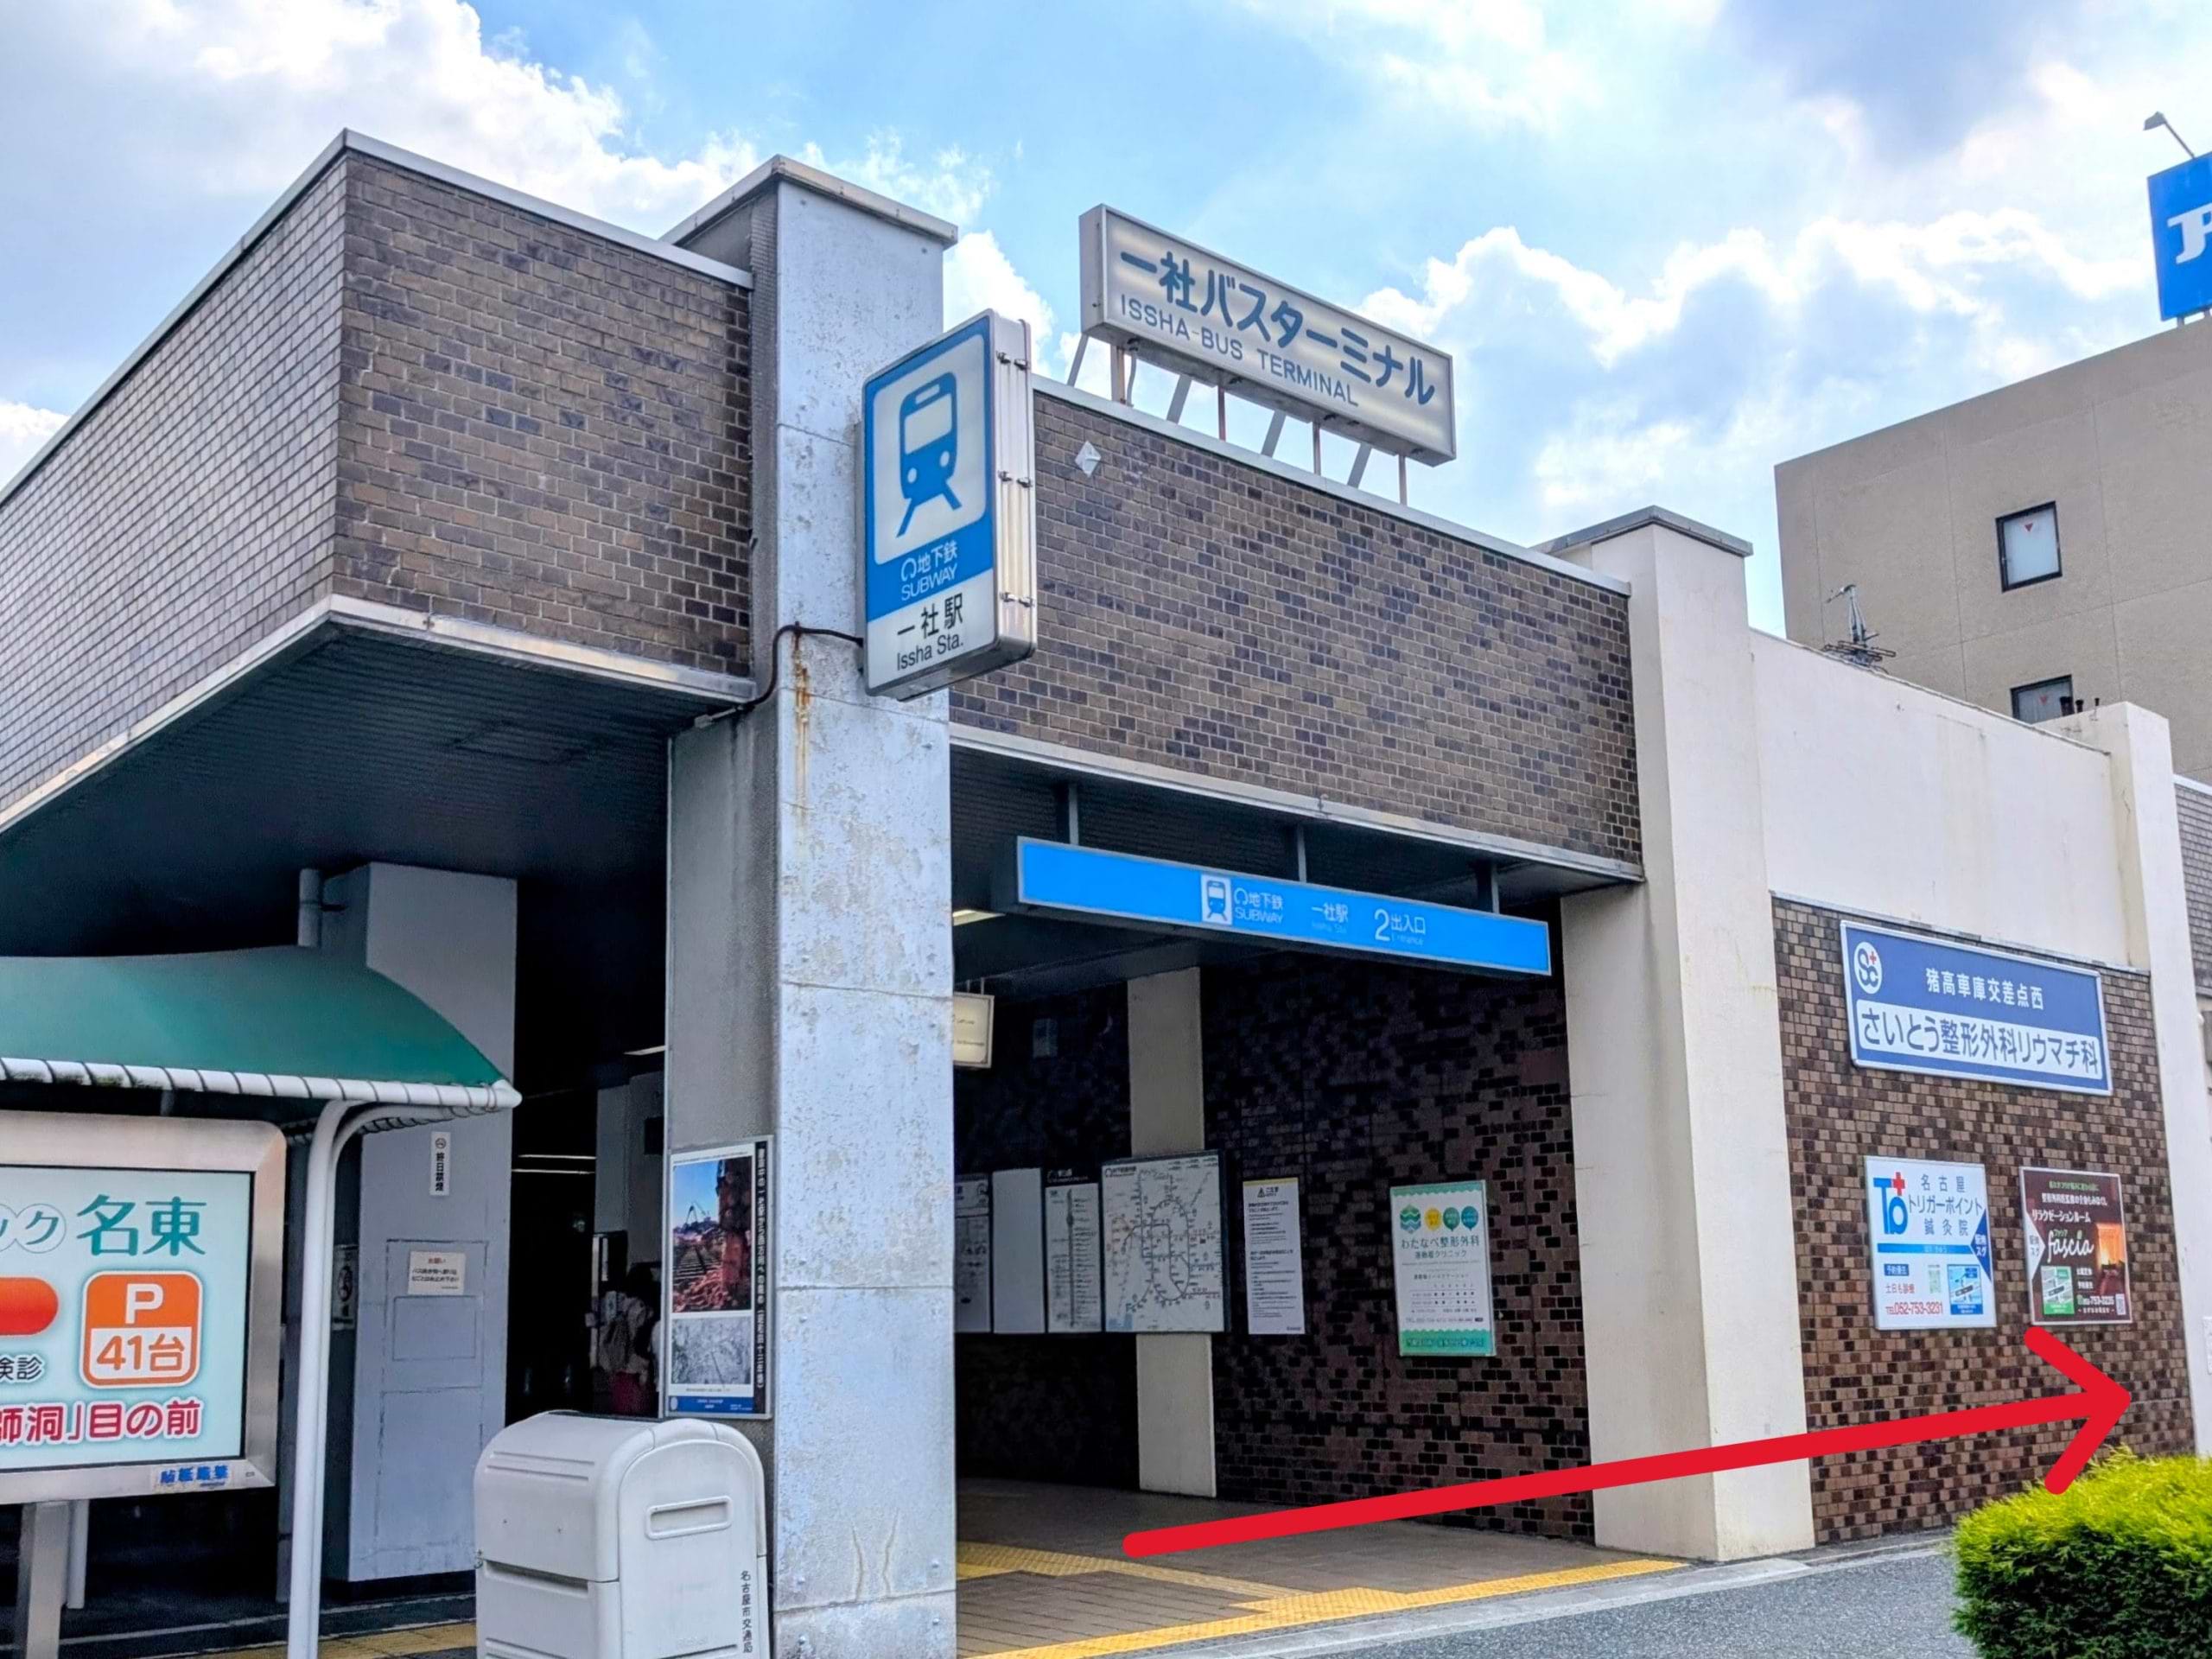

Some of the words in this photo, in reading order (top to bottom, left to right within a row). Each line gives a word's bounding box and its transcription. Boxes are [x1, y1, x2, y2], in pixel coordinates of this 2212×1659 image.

[1120, 251, 1436, 406] 一社バスターミナル
[1256, 349, 1360, 407] TERMINAL
[917, 540, 958, 575] 地下鉄
[900, 563, 959, 601] SUBWAY
[896, 592, 963, 639] 一社駅
[897, 644, 933, 671] Issha
[937, 632, 964, 658] Sta.
[1234, 907, 1284, 924] SUBWAY
[1248, 892, 1283, 911] 地下鉄
[1311, 902, 1349, 923] 一社駅
[1925, 967, 2044, 1011] 猪高車庫交差点西
[1861, 1007, 2099, 1074] さいとう整形外科リウマチ科
[1921, 1173, 1966, 1193] 名古屋
[1909, 1195, 1982, 1216] トリガーポイント
[1402, 1235, 1479, 1249] わたなべ整形外科
[2047, 1230, 2094, 1263] fascia
[125, 1283, 164, 1325] P
[96, 1333, 186, 1372] 41台
[741, 1570, 753, 1654] 名古屋市交通局
